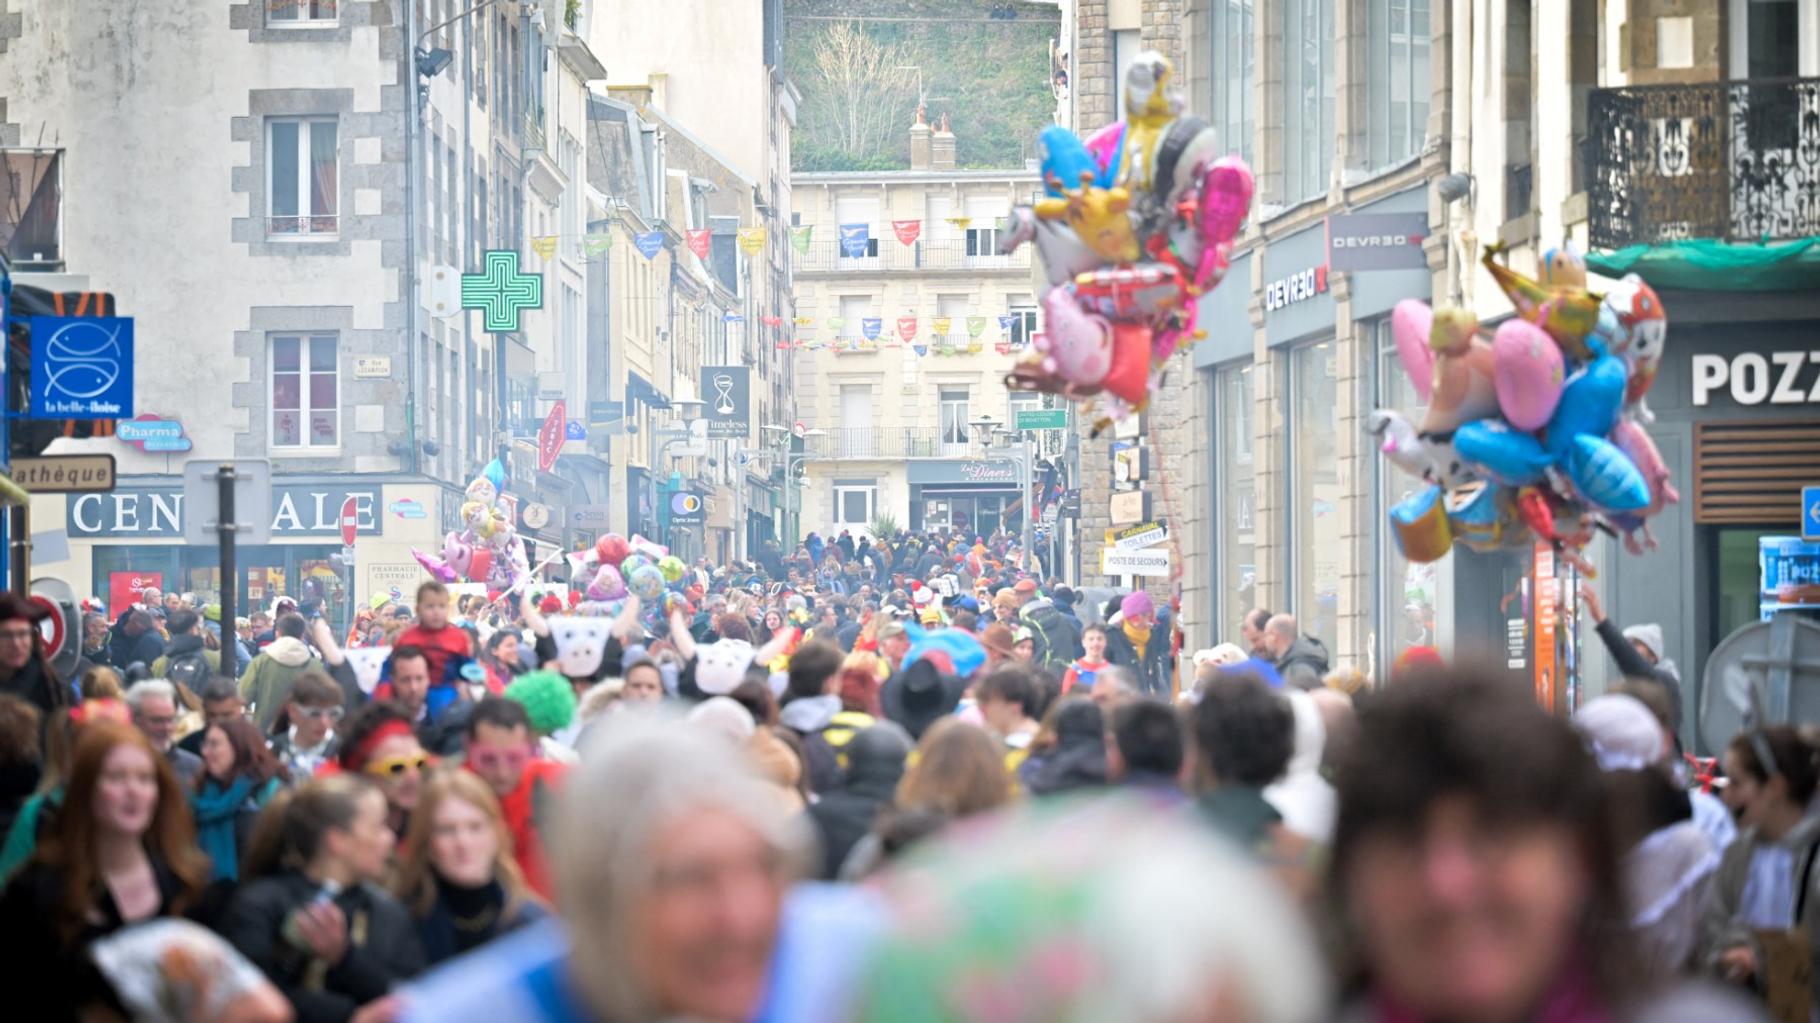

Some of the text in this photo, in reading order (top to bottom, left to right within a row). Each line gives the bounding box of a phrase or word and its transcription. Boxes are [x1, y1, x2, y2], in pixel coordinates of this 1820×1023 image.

[45, 401, 56, 413] la
[120, 424, 179, 438] Pharma
[72, 491, 376, 533] CENALE
[1121, 521, 1159, 539] CARNAVAL
[1123, 530, 1163, 548] TOILETTES
[1108, 557, 1164, 566] POSTE DE SECOURS
